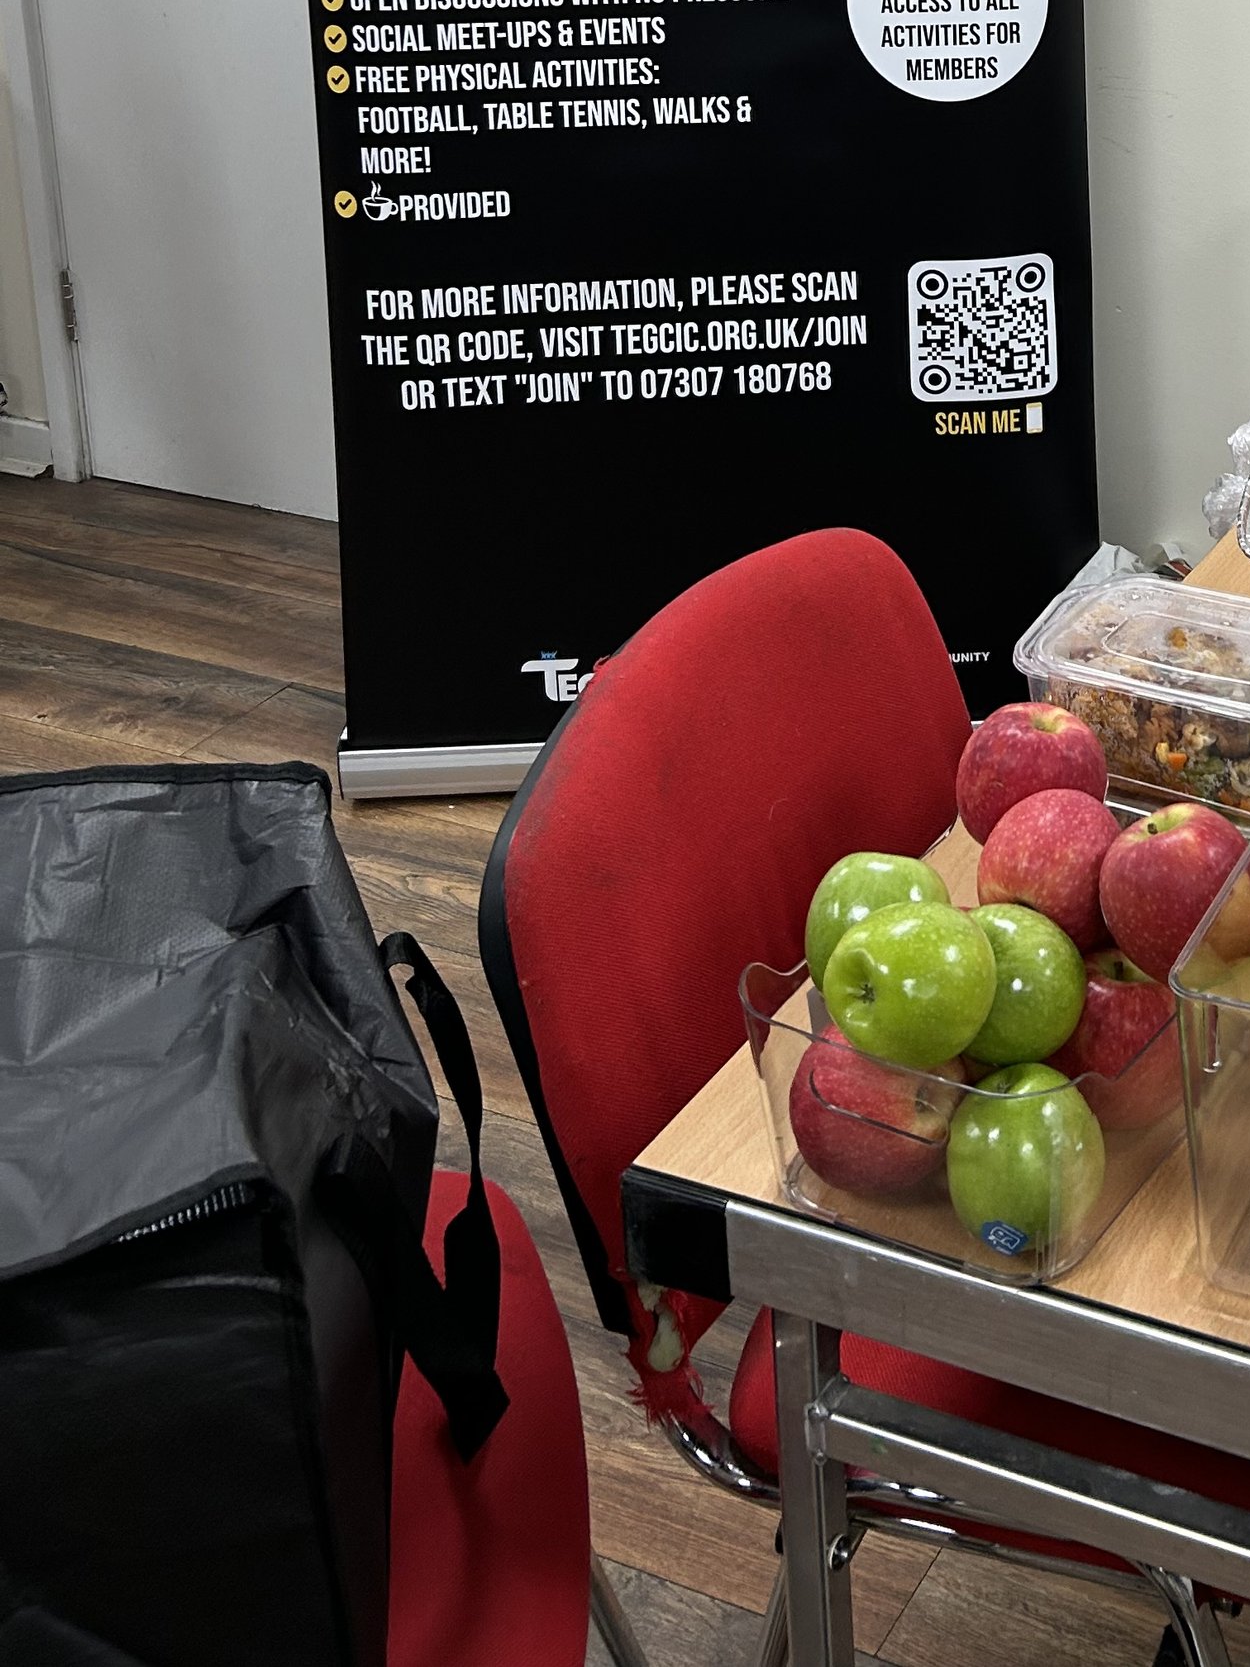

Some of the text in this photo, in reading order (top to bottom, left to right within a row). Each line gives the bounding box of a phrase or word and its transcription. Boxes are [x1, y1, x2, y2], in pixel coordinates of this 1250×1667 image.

[353, 17, 665, 52] SOCIAL MEET-UPS & EVENTS
[881, 22, 1020, 47] ACTIVITIES FOR
[356, 58, 659, 92] FREE PHYSICAL ACTIVITIES:
[907, 57, 998, 81] MEMBERS
[359, 96, 751, 134] FOOTBALL, TABLE TENNIS, WALKS &
[361, 147, 431, 173] MORE!
[400, 191, 510, 221] PROVIDED
[367, 272, 857, 320] FOR MORE INFORMATION, PLEASE SCAN
[361, 316, 867, 366] THE QR CODE, VISIT TEGCIC.ORG.UK/JOIN
[402, 362, 831, 410] OR TEXT "JOIN" TO 07307 180768
[936, 409, 1020, 434] SCAN ME
